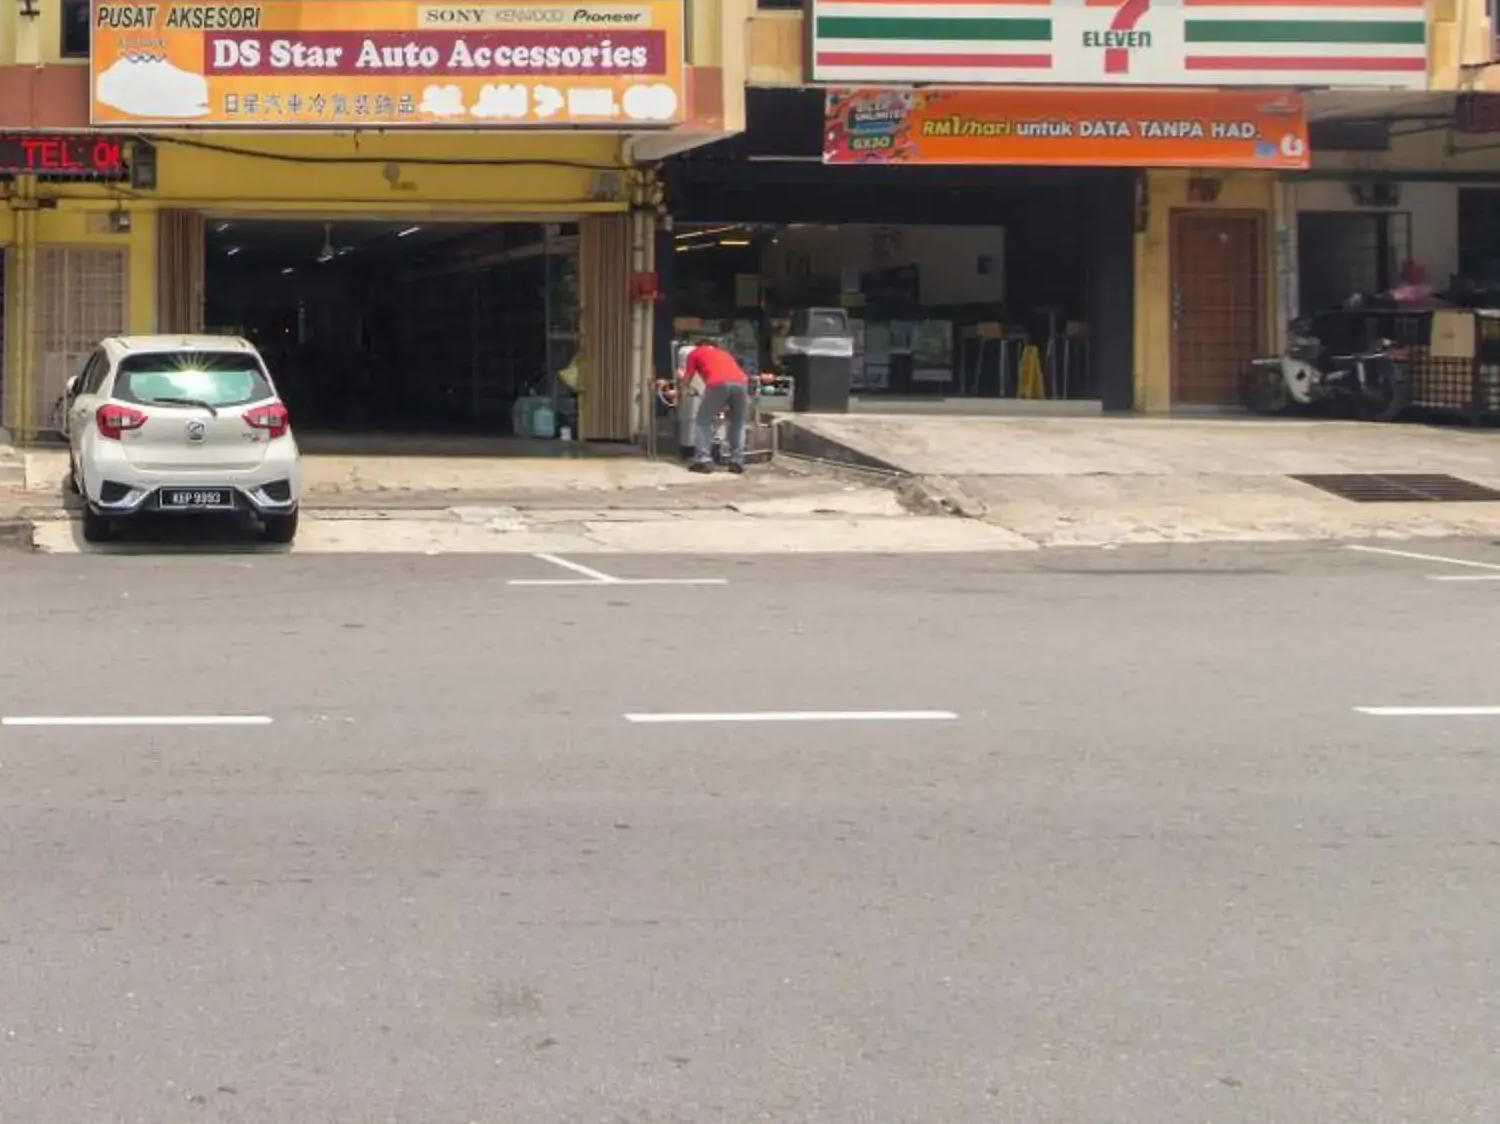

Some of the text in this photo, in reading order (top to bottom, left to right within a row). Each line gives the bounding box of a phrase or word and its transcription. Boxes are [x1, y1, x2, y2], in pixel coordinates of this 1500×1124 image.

[97, 7, 260, 29] PUSAT AKSESORI
[426, 9, 486, 23] SONY
[573, 9, 641, 23] Pioneer
[213, 38, 647, 69] DS Star Auto Accessories
[1017, 120, 1072, 136] untuk
[1079, 120, 1131, 137] DATA
[1139, 121, 1203, 137] TANPA
[1211, 122, 1263, 138] HAD.
